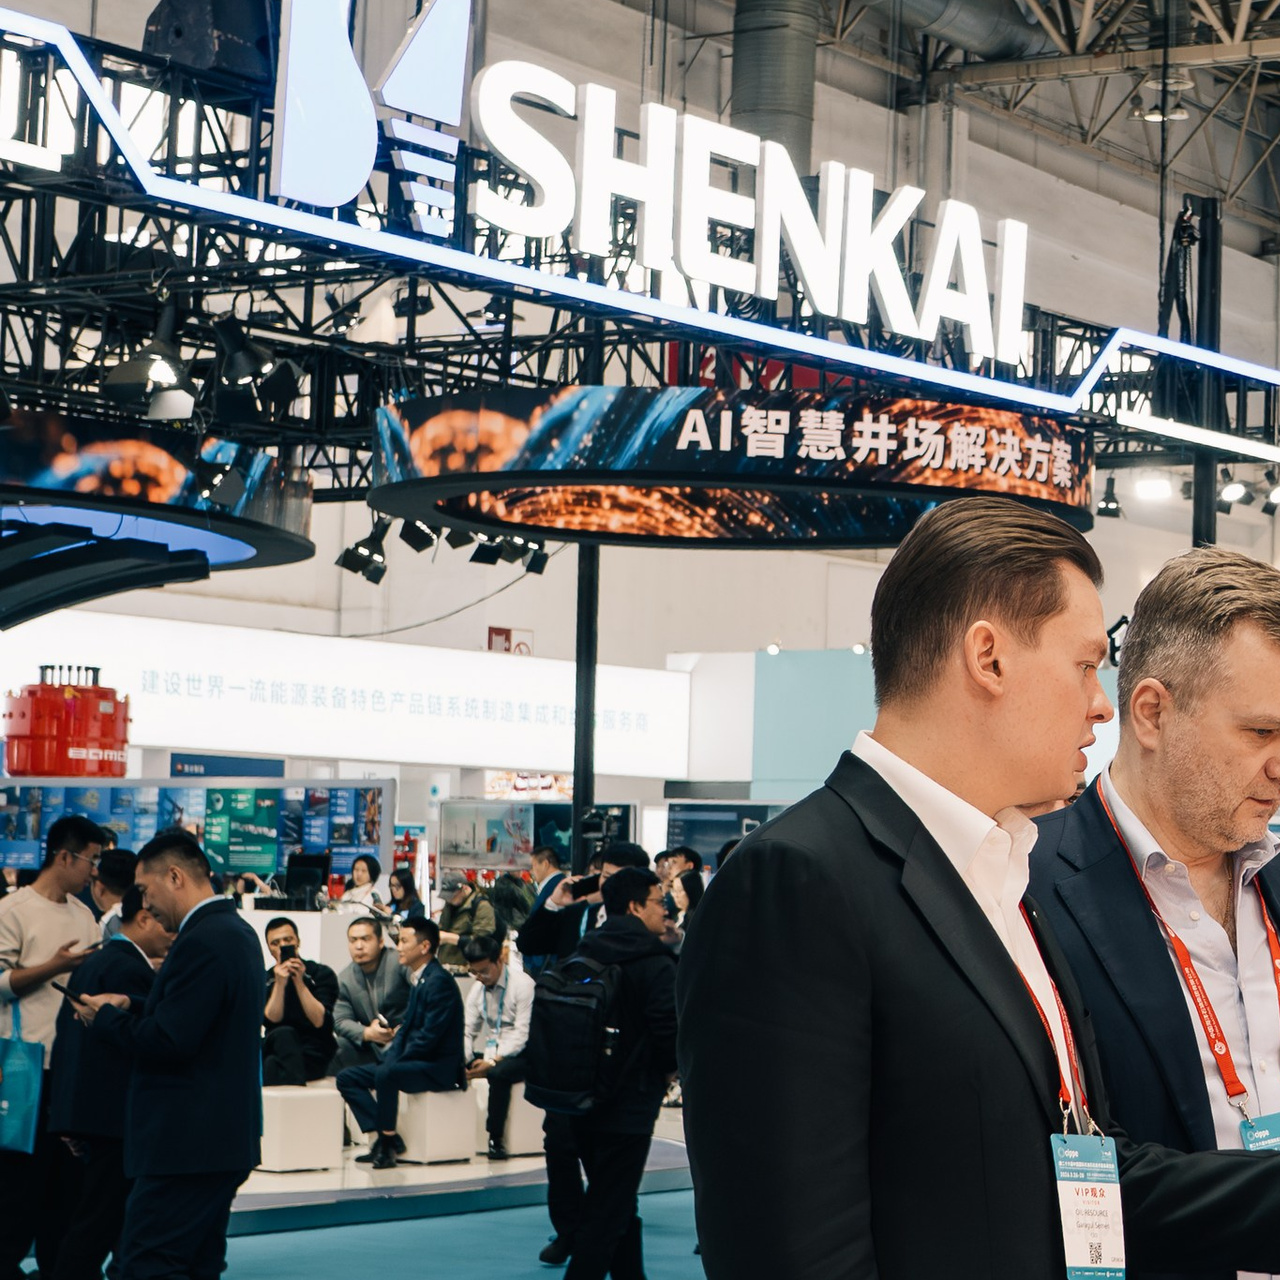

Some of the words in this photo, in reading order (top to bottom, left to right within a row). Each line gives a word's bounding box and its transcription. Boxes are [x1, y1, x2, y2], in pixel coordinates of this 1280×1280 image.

[471, 60, 1029, 365] SHENKAI
[676, 404, 1074, 489] AI智慧井场解决方案
[141, 669, 650, 733] 建设世界一流能源装备特色产品链系统制造集成和服务商
